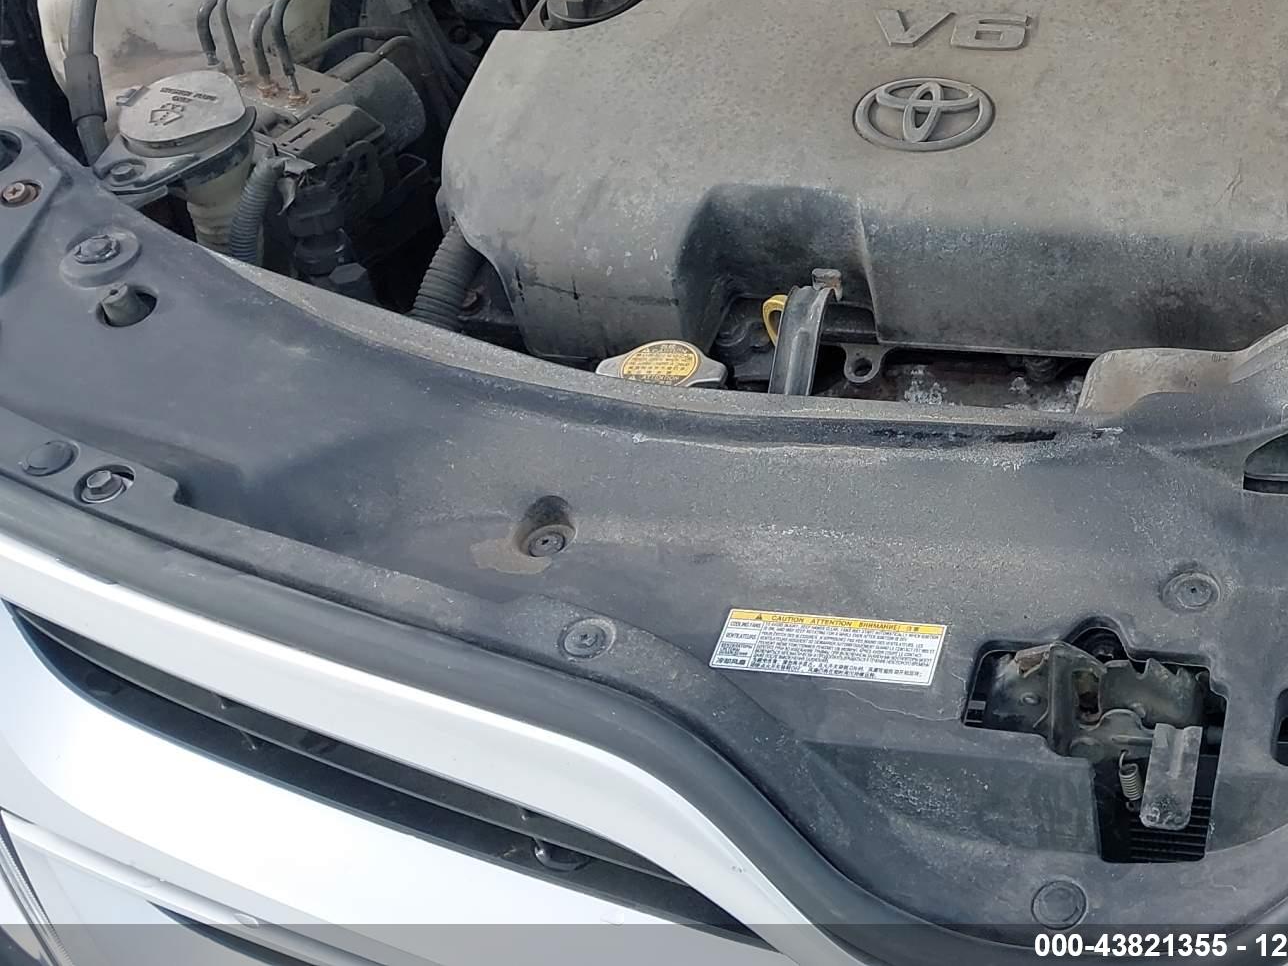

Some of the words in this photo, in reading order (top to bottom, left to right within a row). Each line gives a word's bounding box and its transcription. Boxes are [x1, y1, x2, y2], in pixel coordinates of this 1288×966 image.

[874, 9, 1033, 51] V6
[771, 615, 805, 623] CAUTION
[811, 618, 852, 627] ATTENTION
